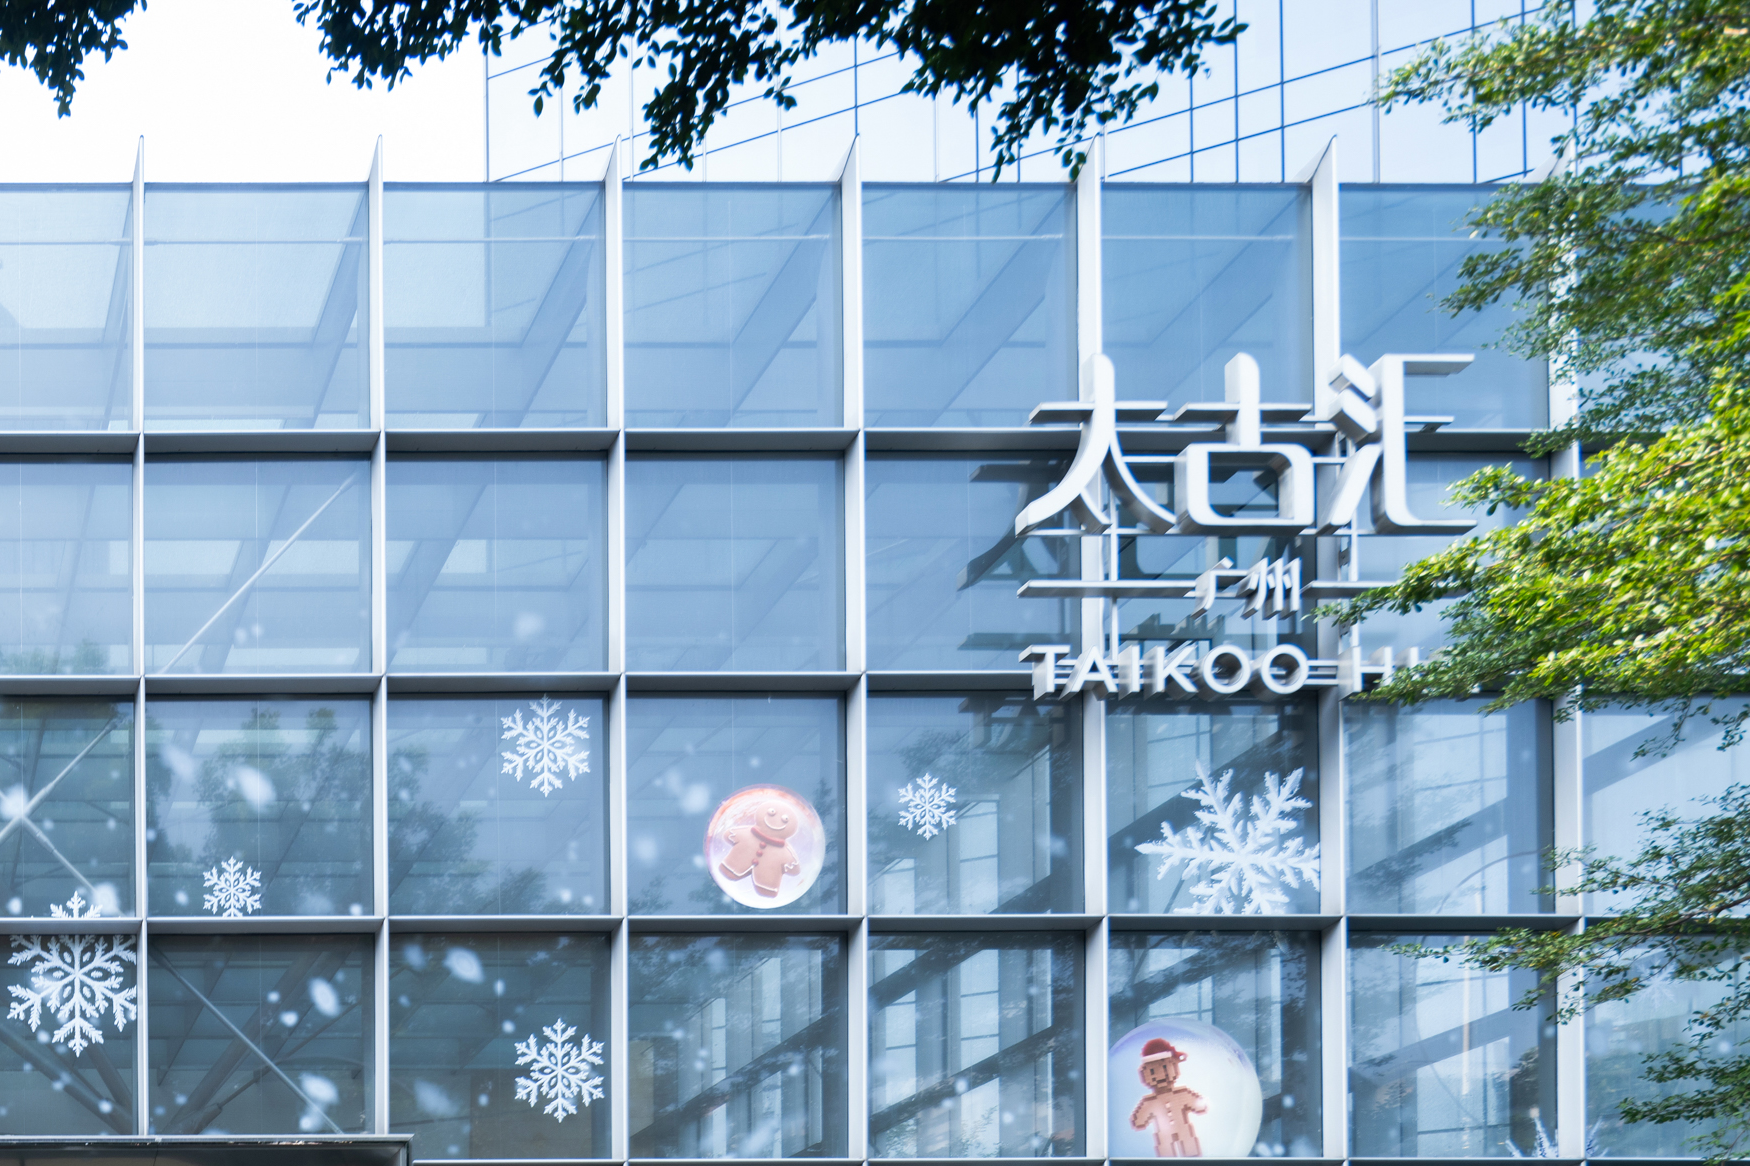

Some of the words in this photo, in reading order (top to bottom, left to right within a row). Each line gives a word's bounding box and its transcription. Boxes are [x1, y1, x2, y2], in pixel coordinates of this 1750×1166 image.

[1016, 352, 1478, 535] 太古汇
[1192, 556, 1303, 620] 广州
[1020, 642, 1310, 700] TAIKOO
